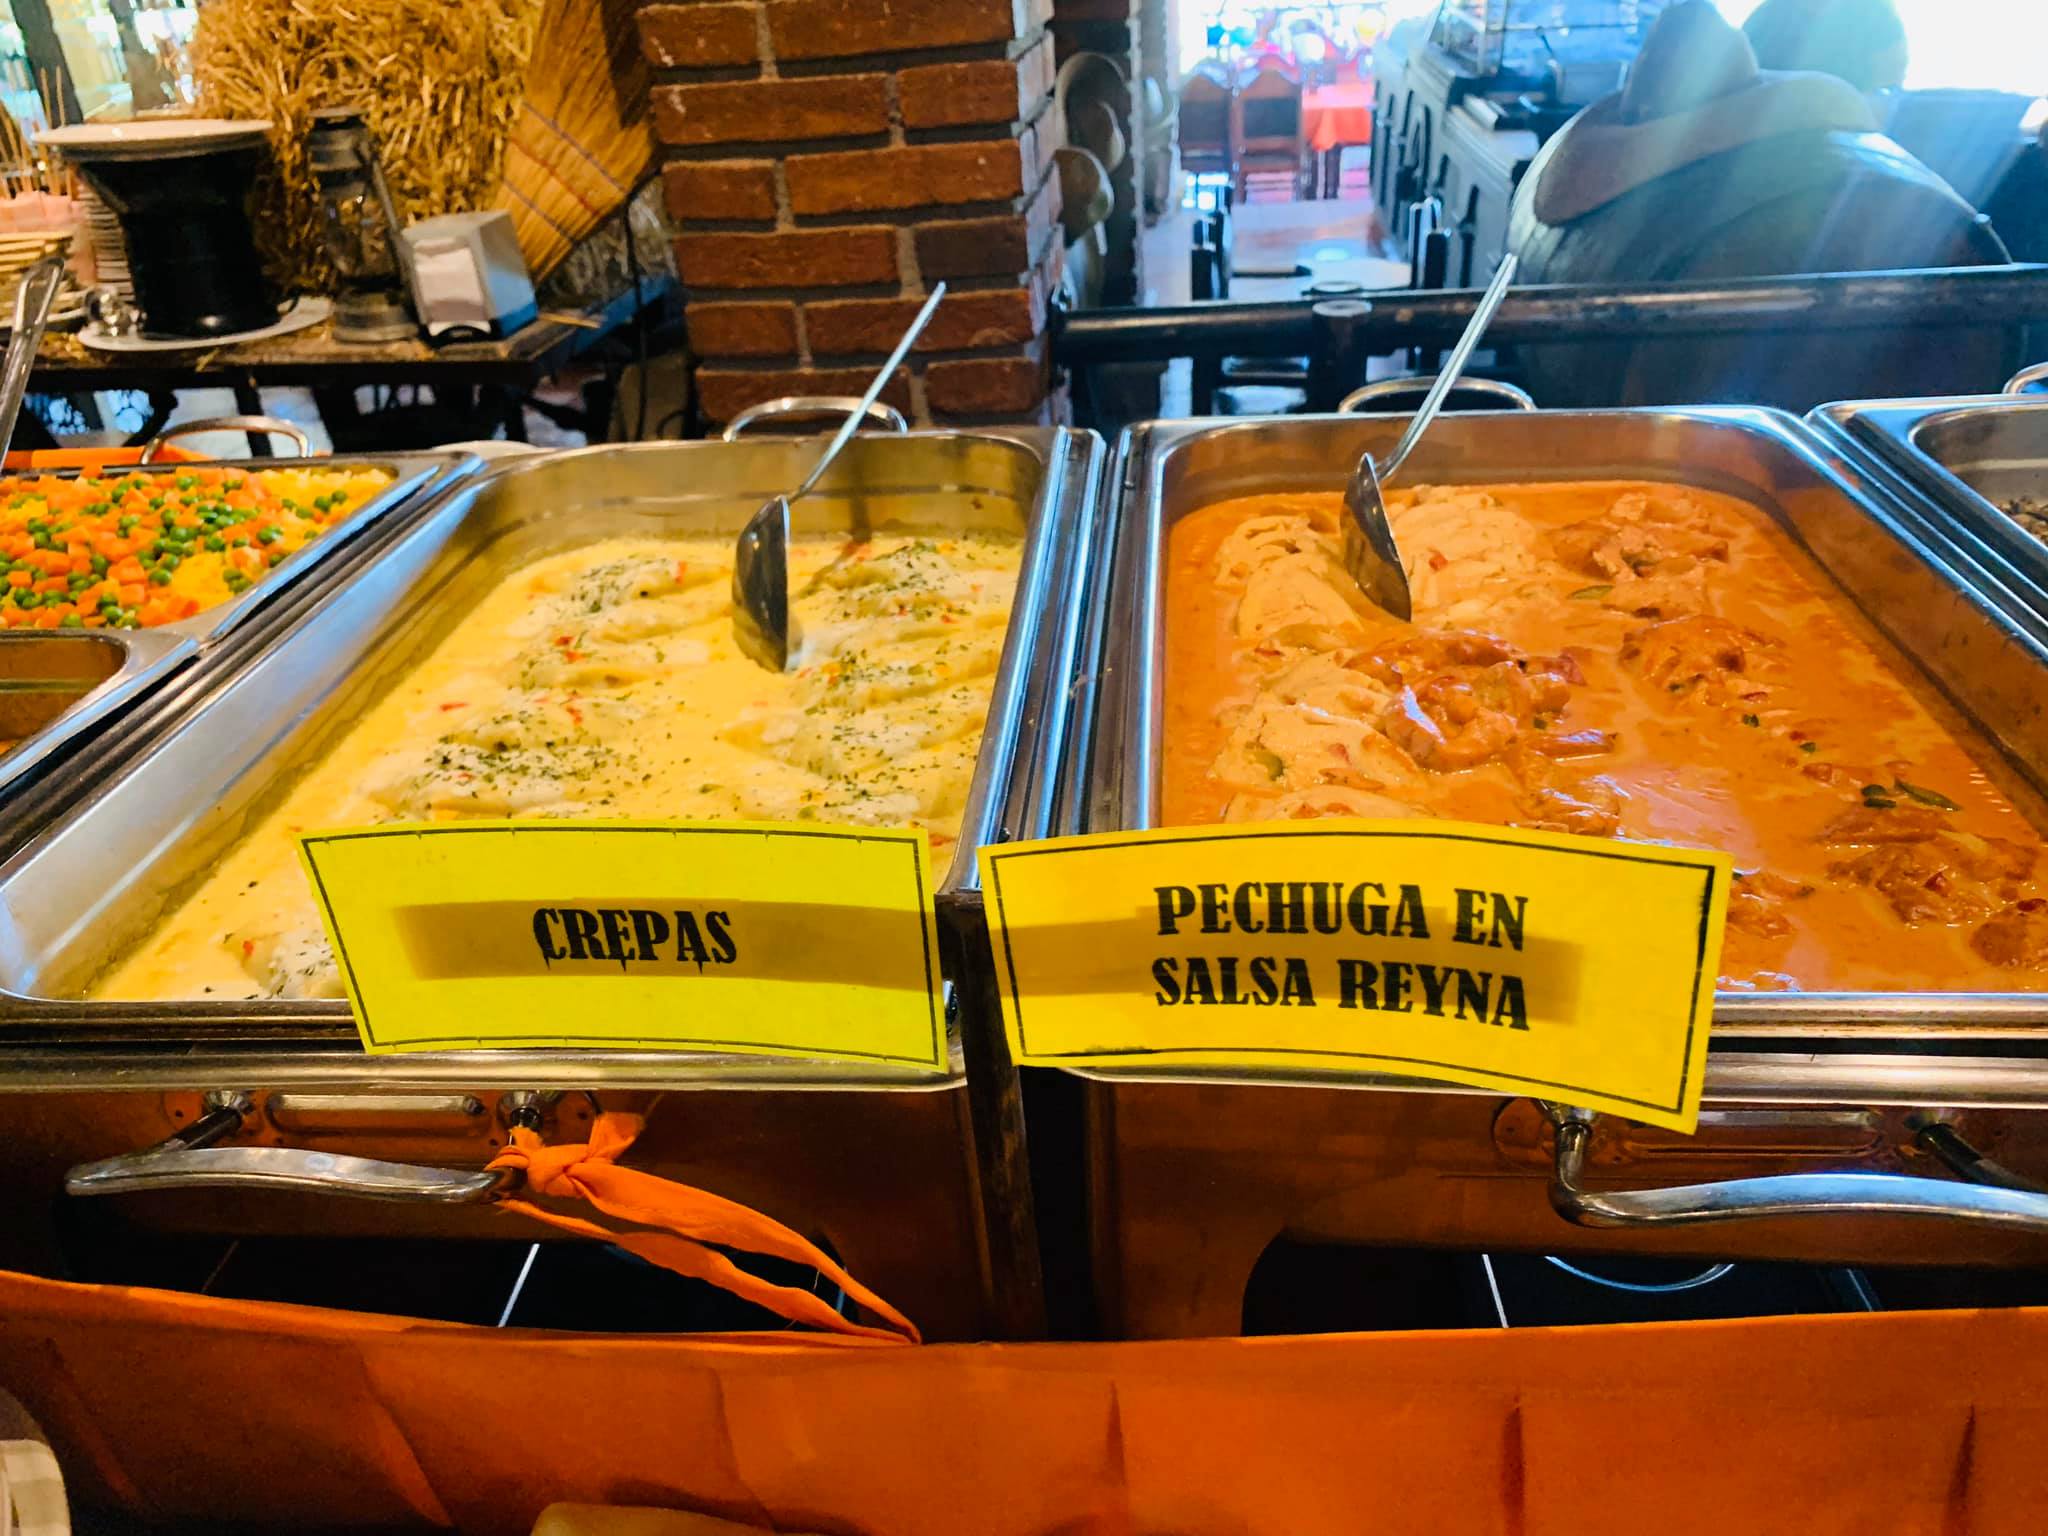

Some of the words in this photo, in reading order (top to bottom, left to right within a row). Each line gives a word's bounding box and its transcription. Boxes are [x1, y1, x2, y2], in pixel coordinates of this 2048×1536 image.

[532, 907, 738, 969] CREPAS
[1153, 881, 1431, 940] PECHUGA
[1452, 886, 1529, 953] EN
[1151, 955, 1318, 1008] SALSA
[1336, 957, 1531, 1032] REYNA
